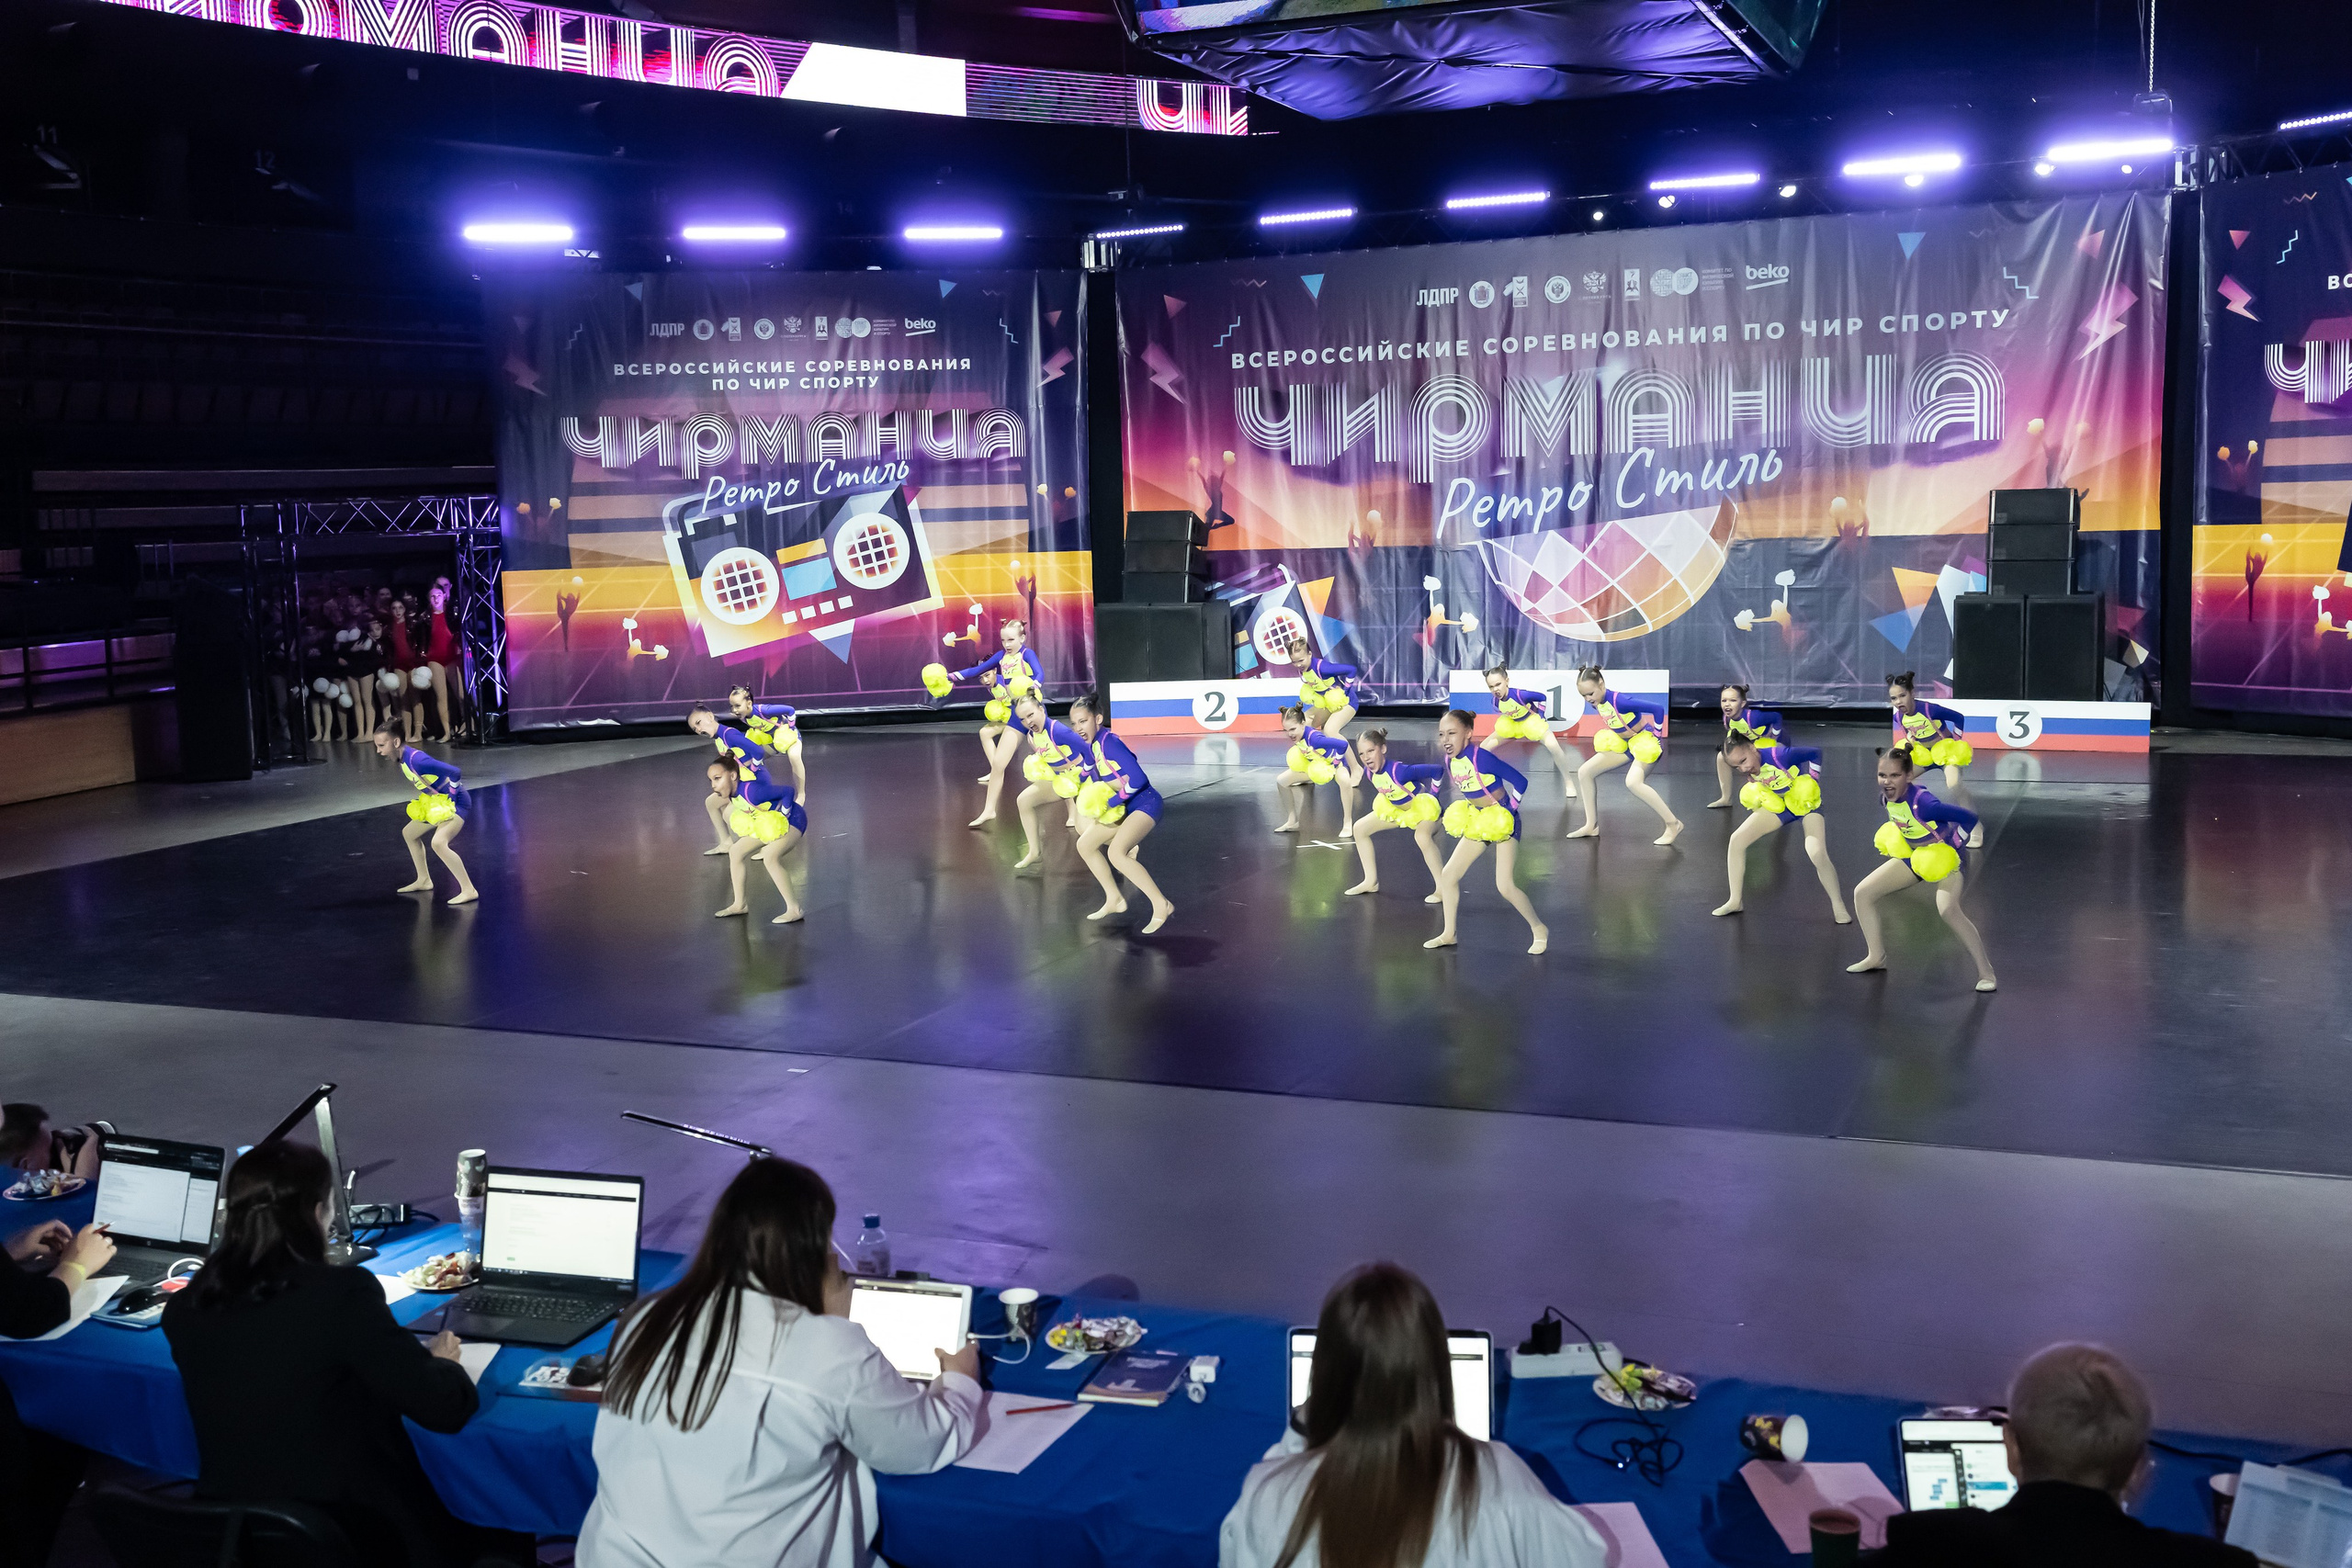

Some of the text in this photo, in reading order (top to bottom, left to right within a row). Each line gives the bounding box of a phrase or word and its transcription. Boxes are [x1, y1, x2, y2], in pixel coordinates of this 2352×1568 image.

[36, 123, 58, 145] 11
[254, 149, 276, 169] 12
[1746, 264, 1790, 279] beko
[1416, 288, 1460, 308] ЛДПР
[650, 322, 685, 337] ЛДПР
[904, 318, 937, 330] beko
[1231, 309, 2010, 369] ВСЕРОССИЙСКИЕ СОРЕВНОВАНИЯ ПО ЧИР СПОРТУ
[614, 357, 971, 376] ВСЕРОССИЙСКИЕ СОРЕВНОВАНИЯ
[712, 376, 879, 391] ПО ЧИР СПОРТУ
[701, 458, 910, 514] Ретро Стиль
[1436, 446, 1783, 539] Ретро Стиль
[1204, 691, 1227, 722] 2
[1546, 684, 1566, 722] 1
[2008, 710, 2030, 739] 3
